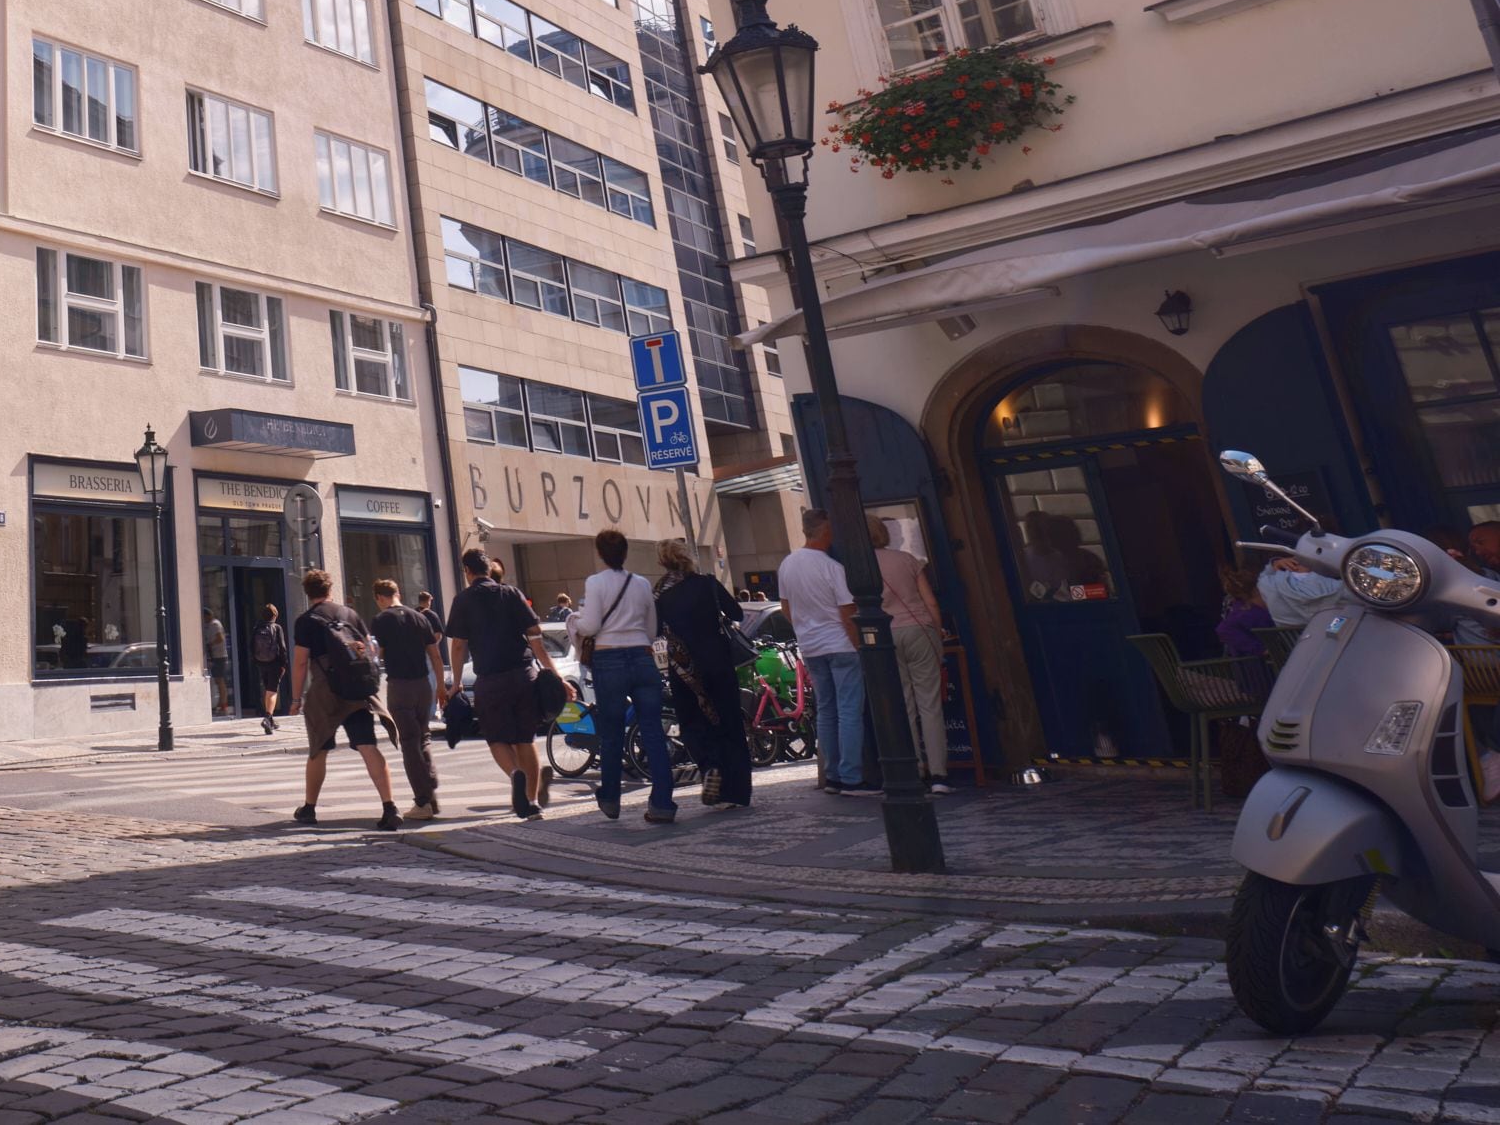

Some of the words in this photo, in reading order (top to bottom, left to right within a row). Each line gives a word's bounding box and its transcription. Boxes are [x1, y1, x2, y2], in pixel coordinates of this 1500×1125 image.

[649, 399, 679, 443] P
[69, 474, 133, 493] BRASSERIA
[220, 482, 241, 496] THE
[468, 463, 704, 530] BURZOVNÍ
[366, 499, 401, 514] COFFEE
